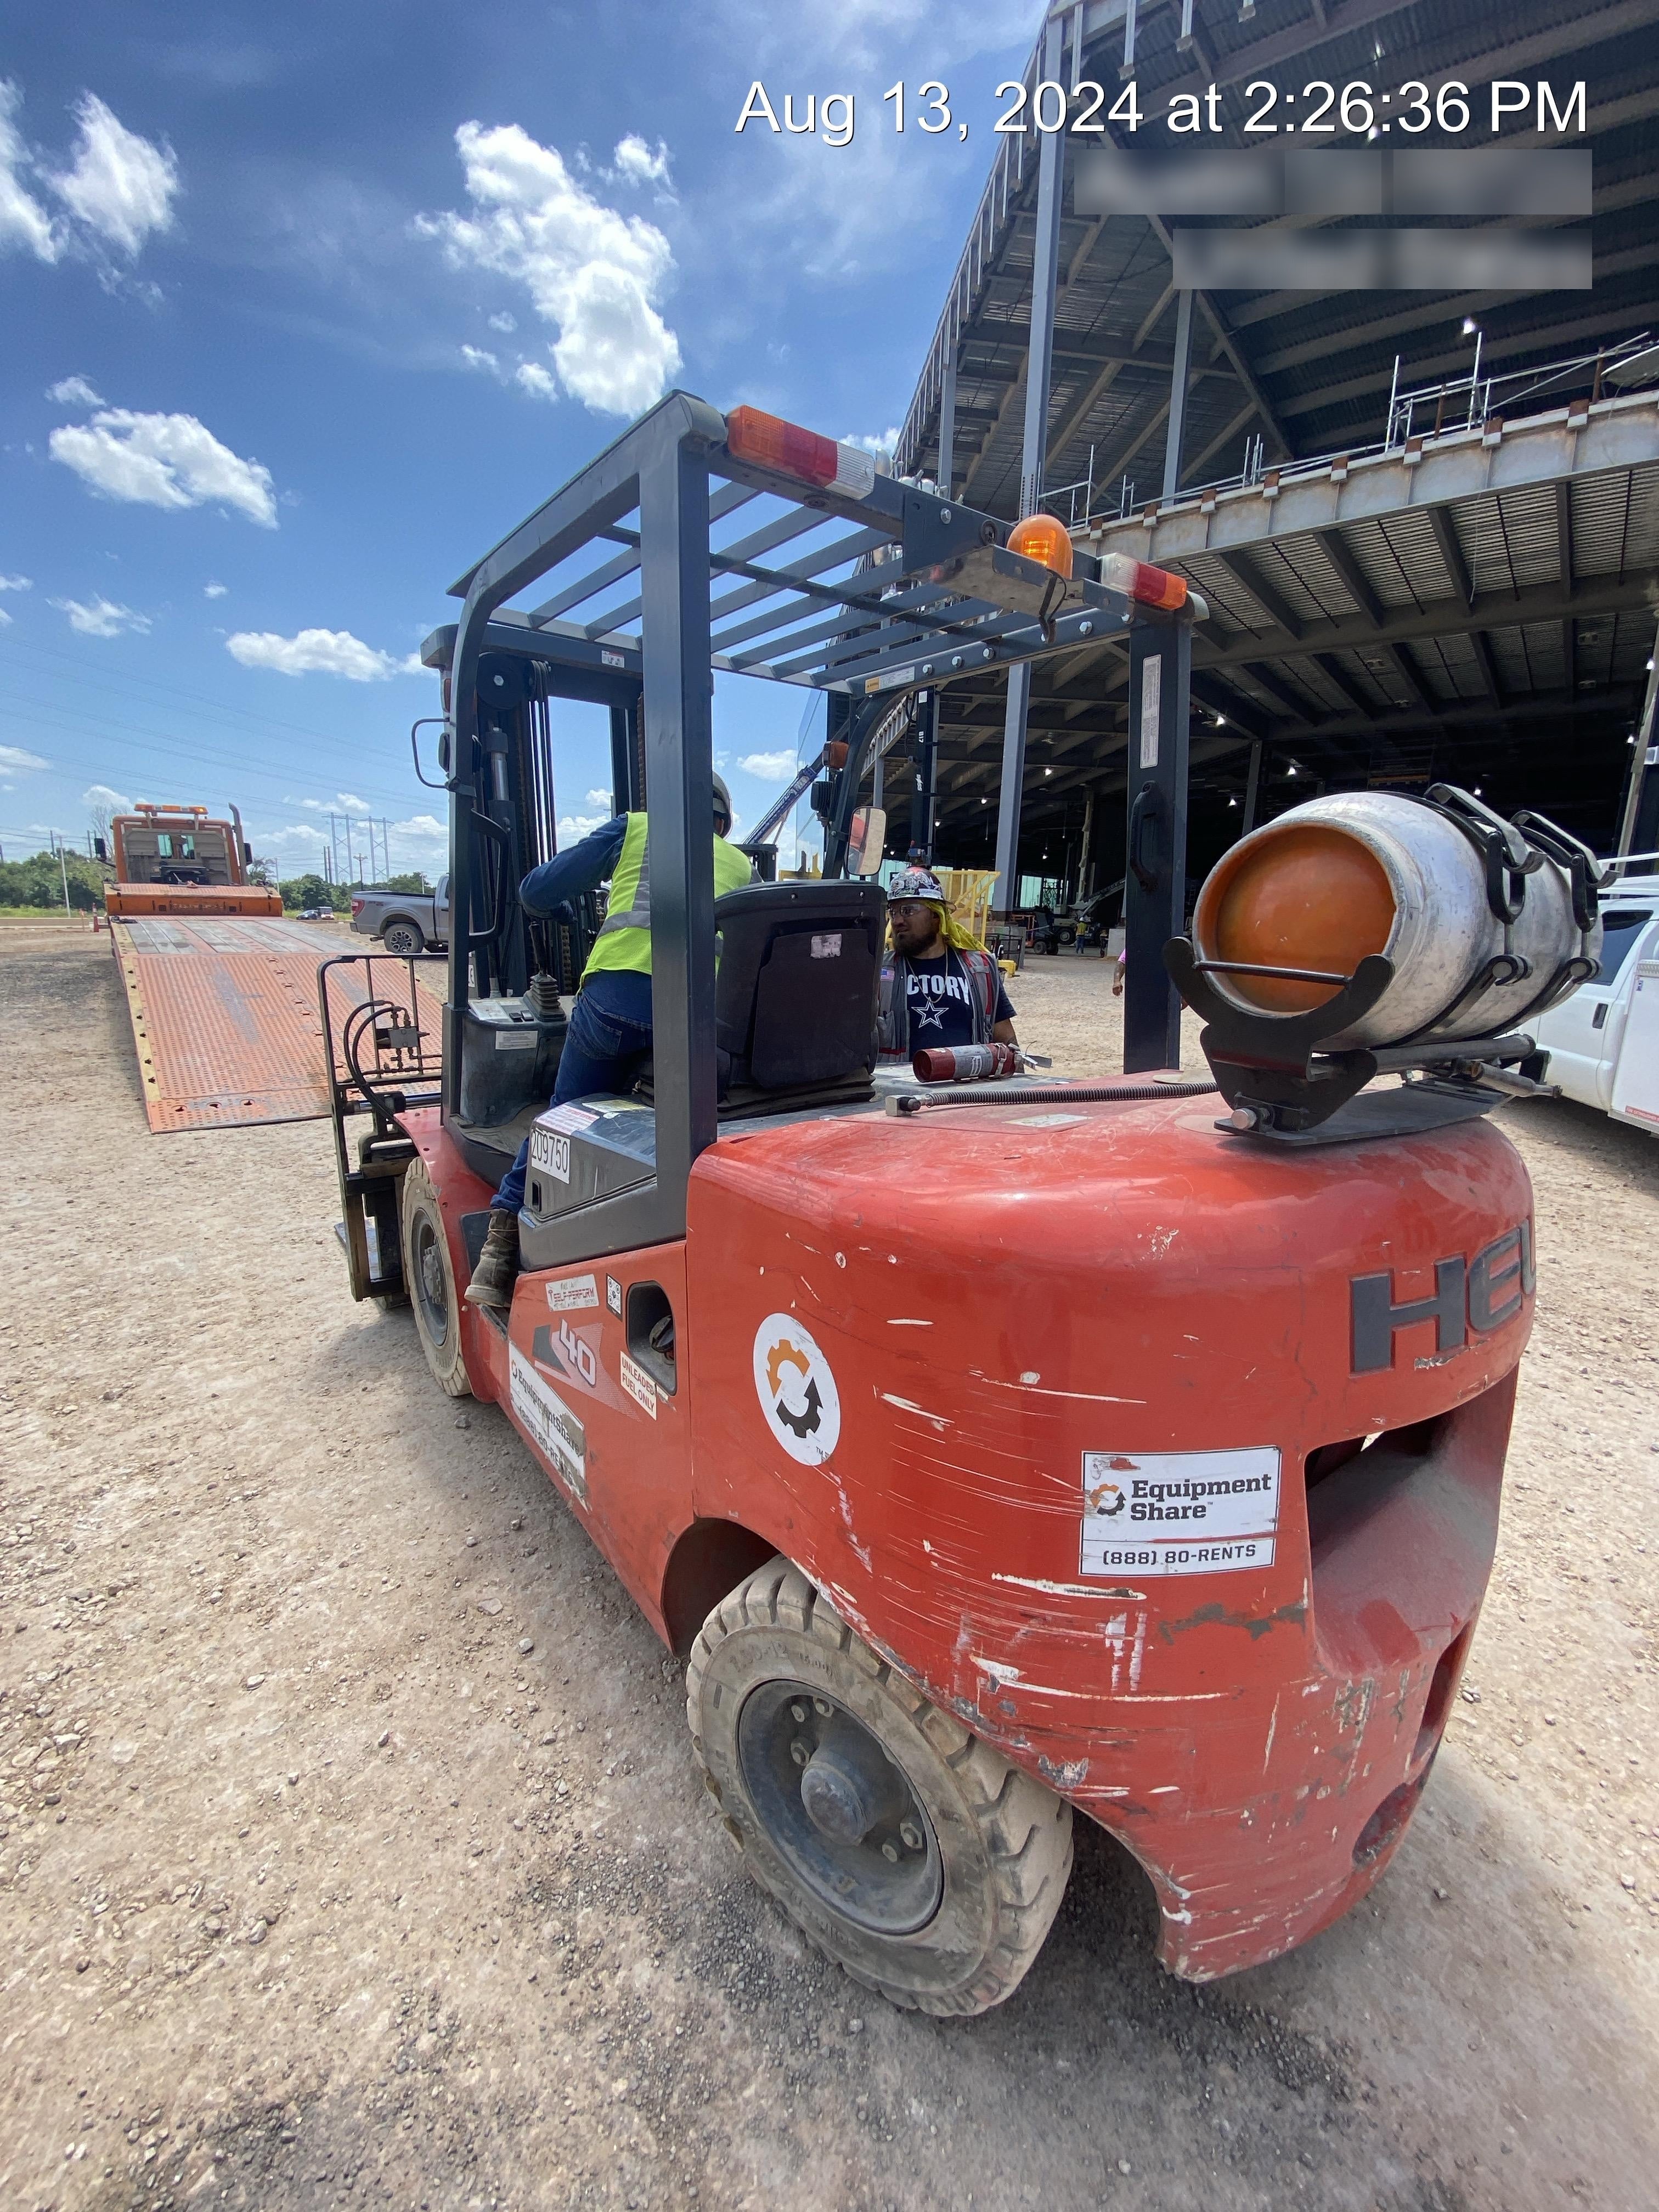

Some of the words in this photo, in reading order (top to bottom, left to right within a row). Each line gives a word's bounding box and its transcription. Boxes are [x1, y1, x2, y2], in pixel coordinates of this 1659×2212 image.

[531, 1128, 568, 1173] 209750
[560, 1318, 596, 1386] 40
[622, 1356, 654, 1396] UNLEADED
[622, 1373, 637, 1396] FUEL
[637, 1389, 654, 1412] ONLY
[1131, 1474, 1272, 1502] Equipment
[1130, 1503, 1206, 1521] Share
[1103, 1550, 1156, 1565] (888)
[1165, 1544, 1256, 1564] 80-RENTS
